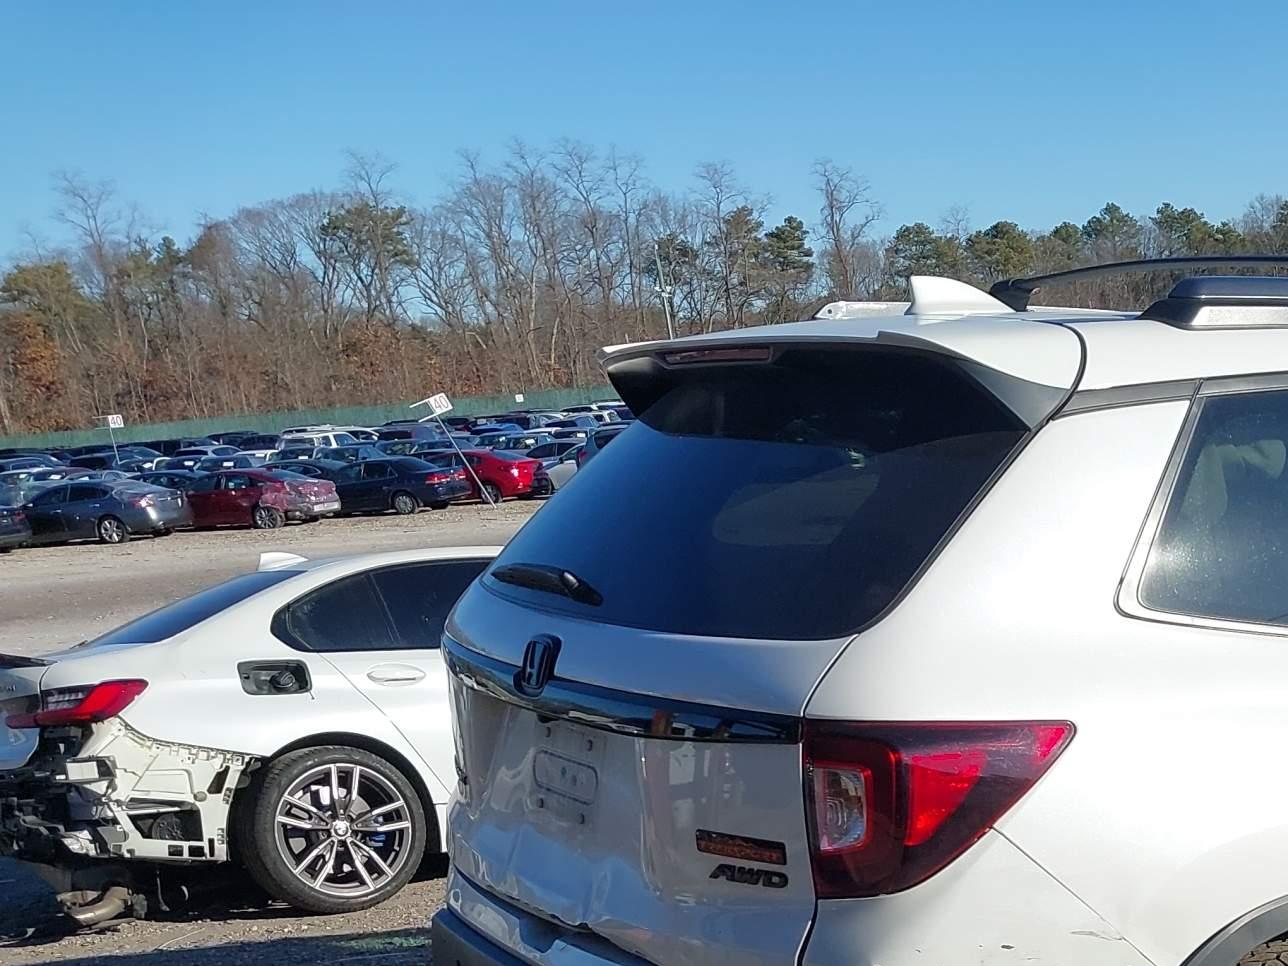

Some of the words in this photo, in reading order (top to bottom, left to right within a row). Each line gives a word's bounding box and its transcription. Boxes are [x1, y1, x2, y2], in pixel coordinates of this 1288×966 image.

[433, 396, 449, 410] 40
[110, 416, 122, 426] 40
[708, 863, 789, 889] AWD
